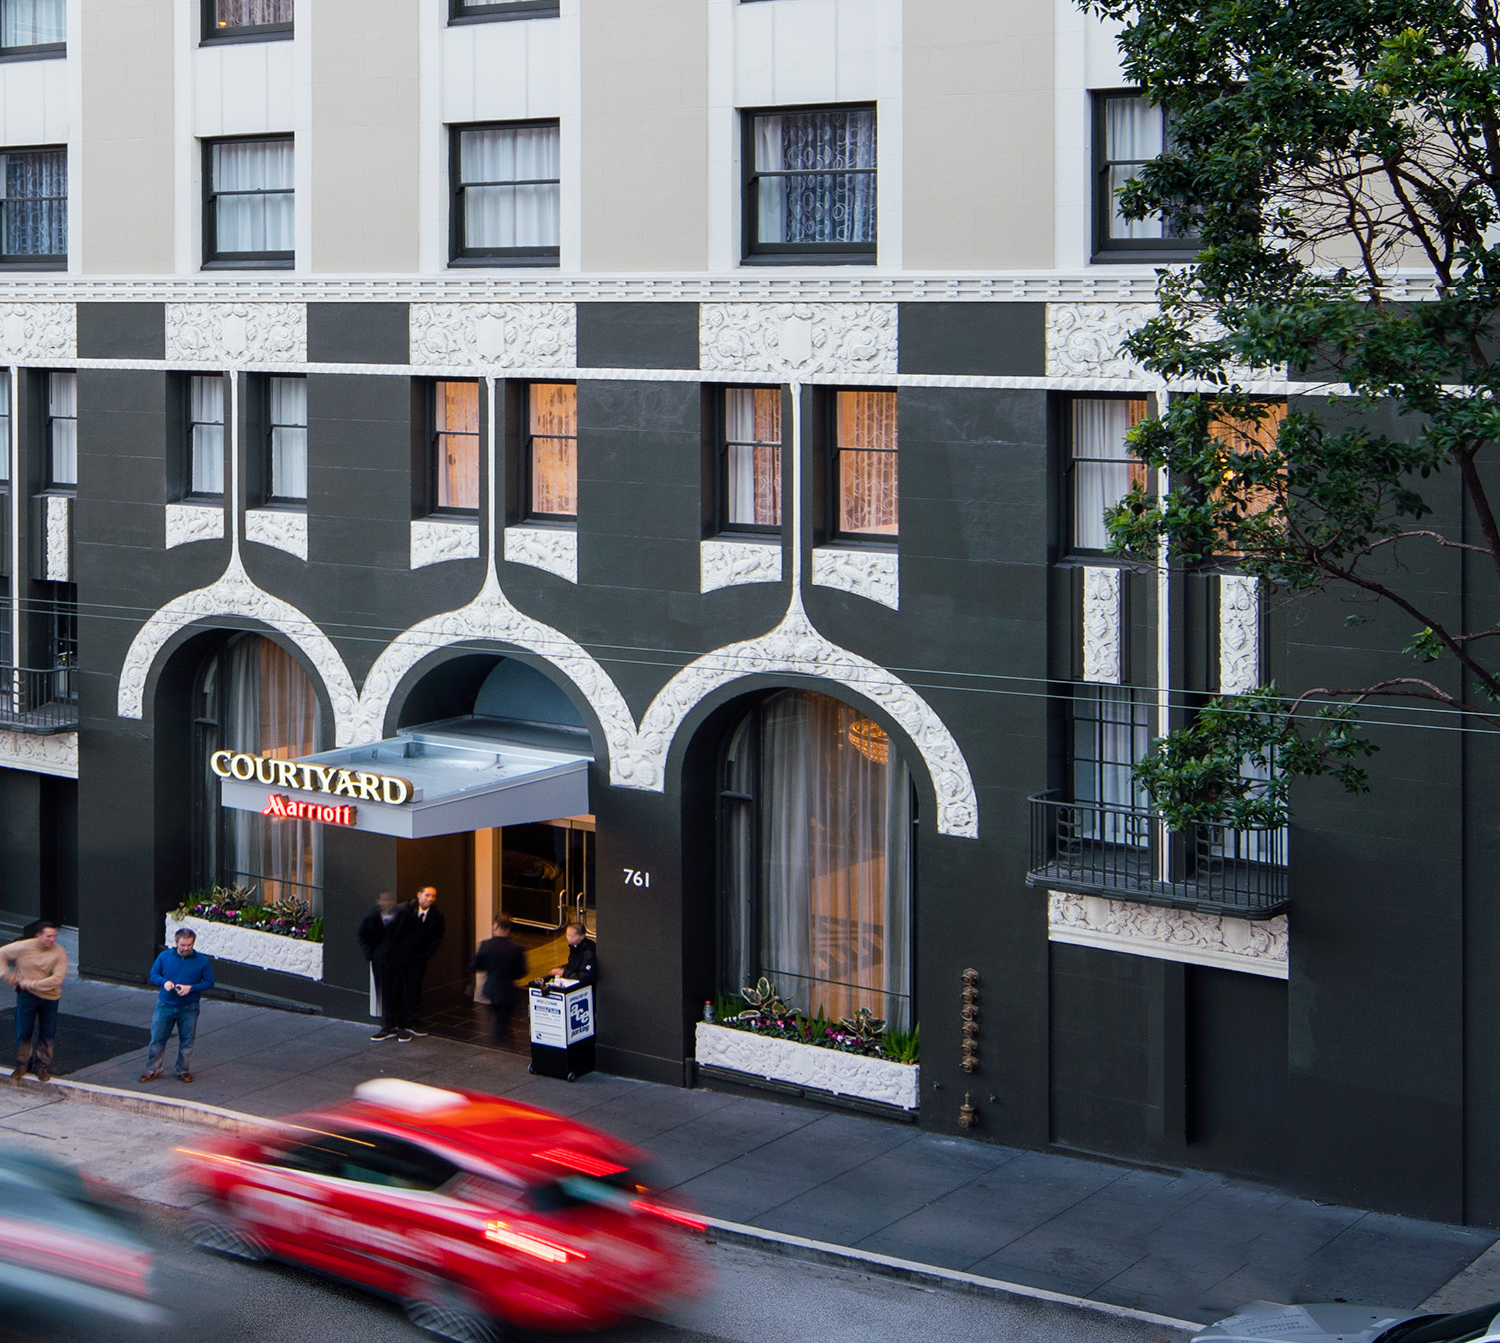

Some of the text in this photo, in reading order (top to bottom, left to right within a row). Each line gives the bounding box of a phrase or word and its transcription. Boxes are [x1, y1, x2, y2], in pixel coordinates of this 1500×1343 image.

[210, 750, 410, 805] COURTYARD
[262, 794, 353, 826] Marriott
[623, 868, 650, 888] 761
[571, 1003, 590, 1024] ace
[571, 1025, 590, 1039] parking
